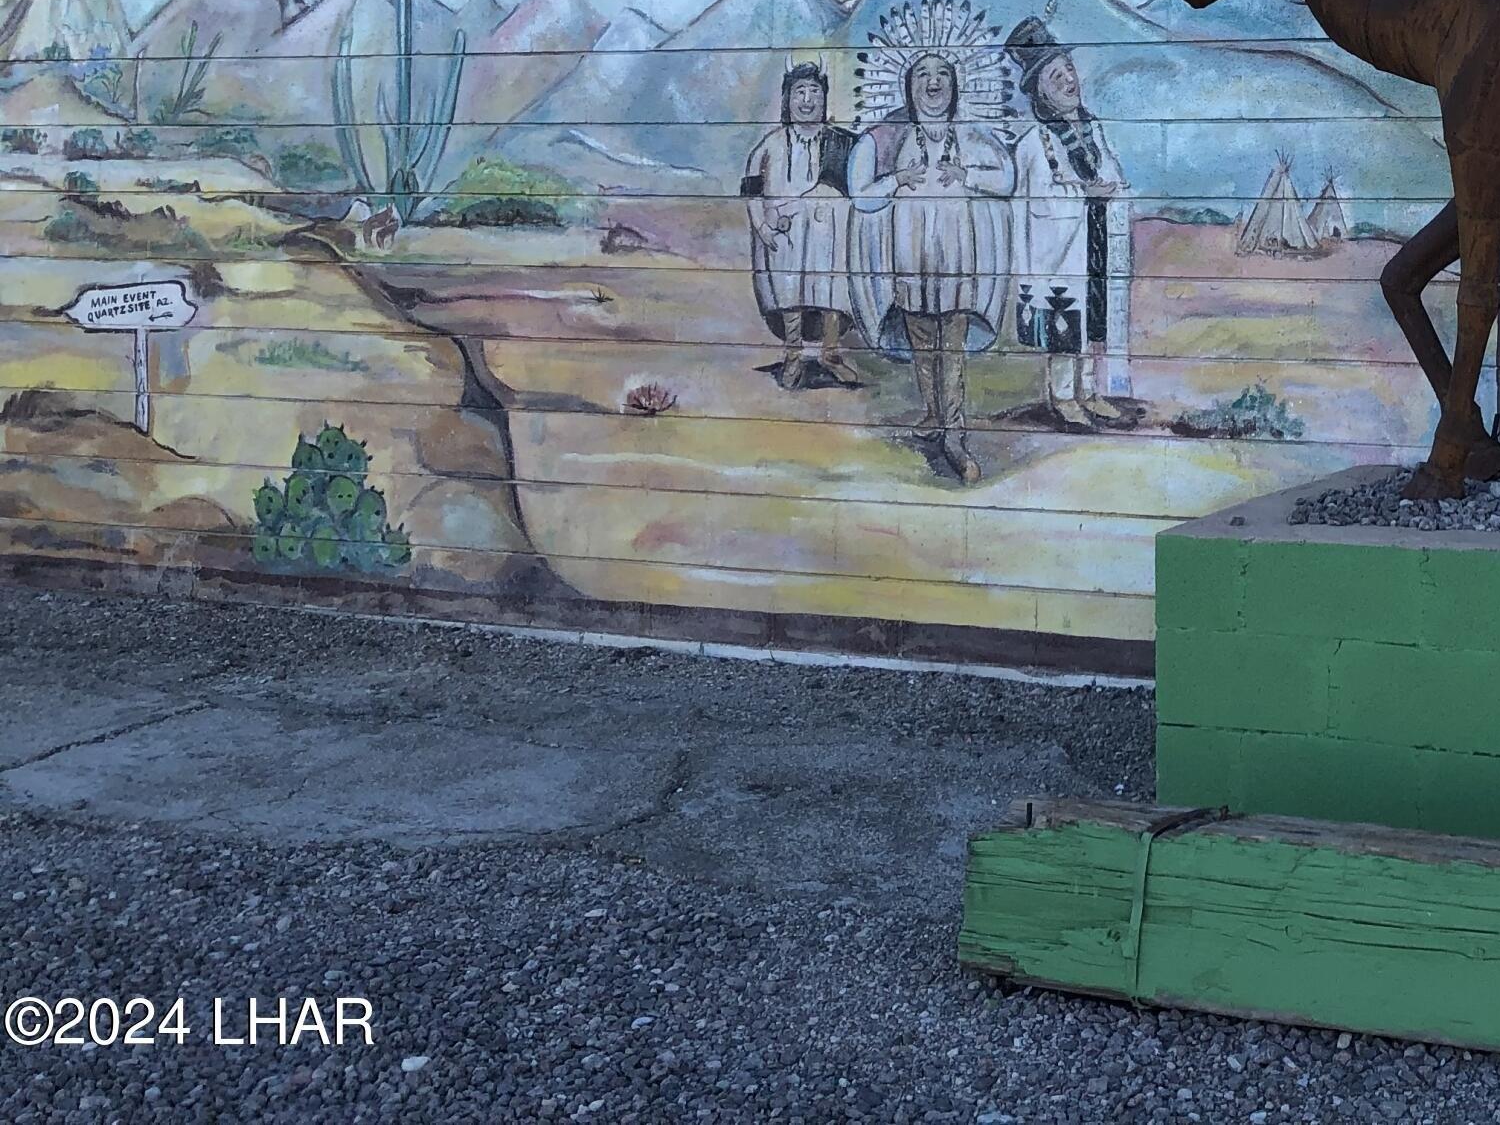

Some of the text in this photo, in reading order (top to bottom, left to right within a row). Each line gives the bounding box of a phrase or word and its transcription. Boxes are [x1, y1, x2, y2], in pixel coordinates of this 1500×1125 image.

[91, 290, 157, 308] MAIN EVENT
[87, 302, 150, 322] QUARTZSITE
